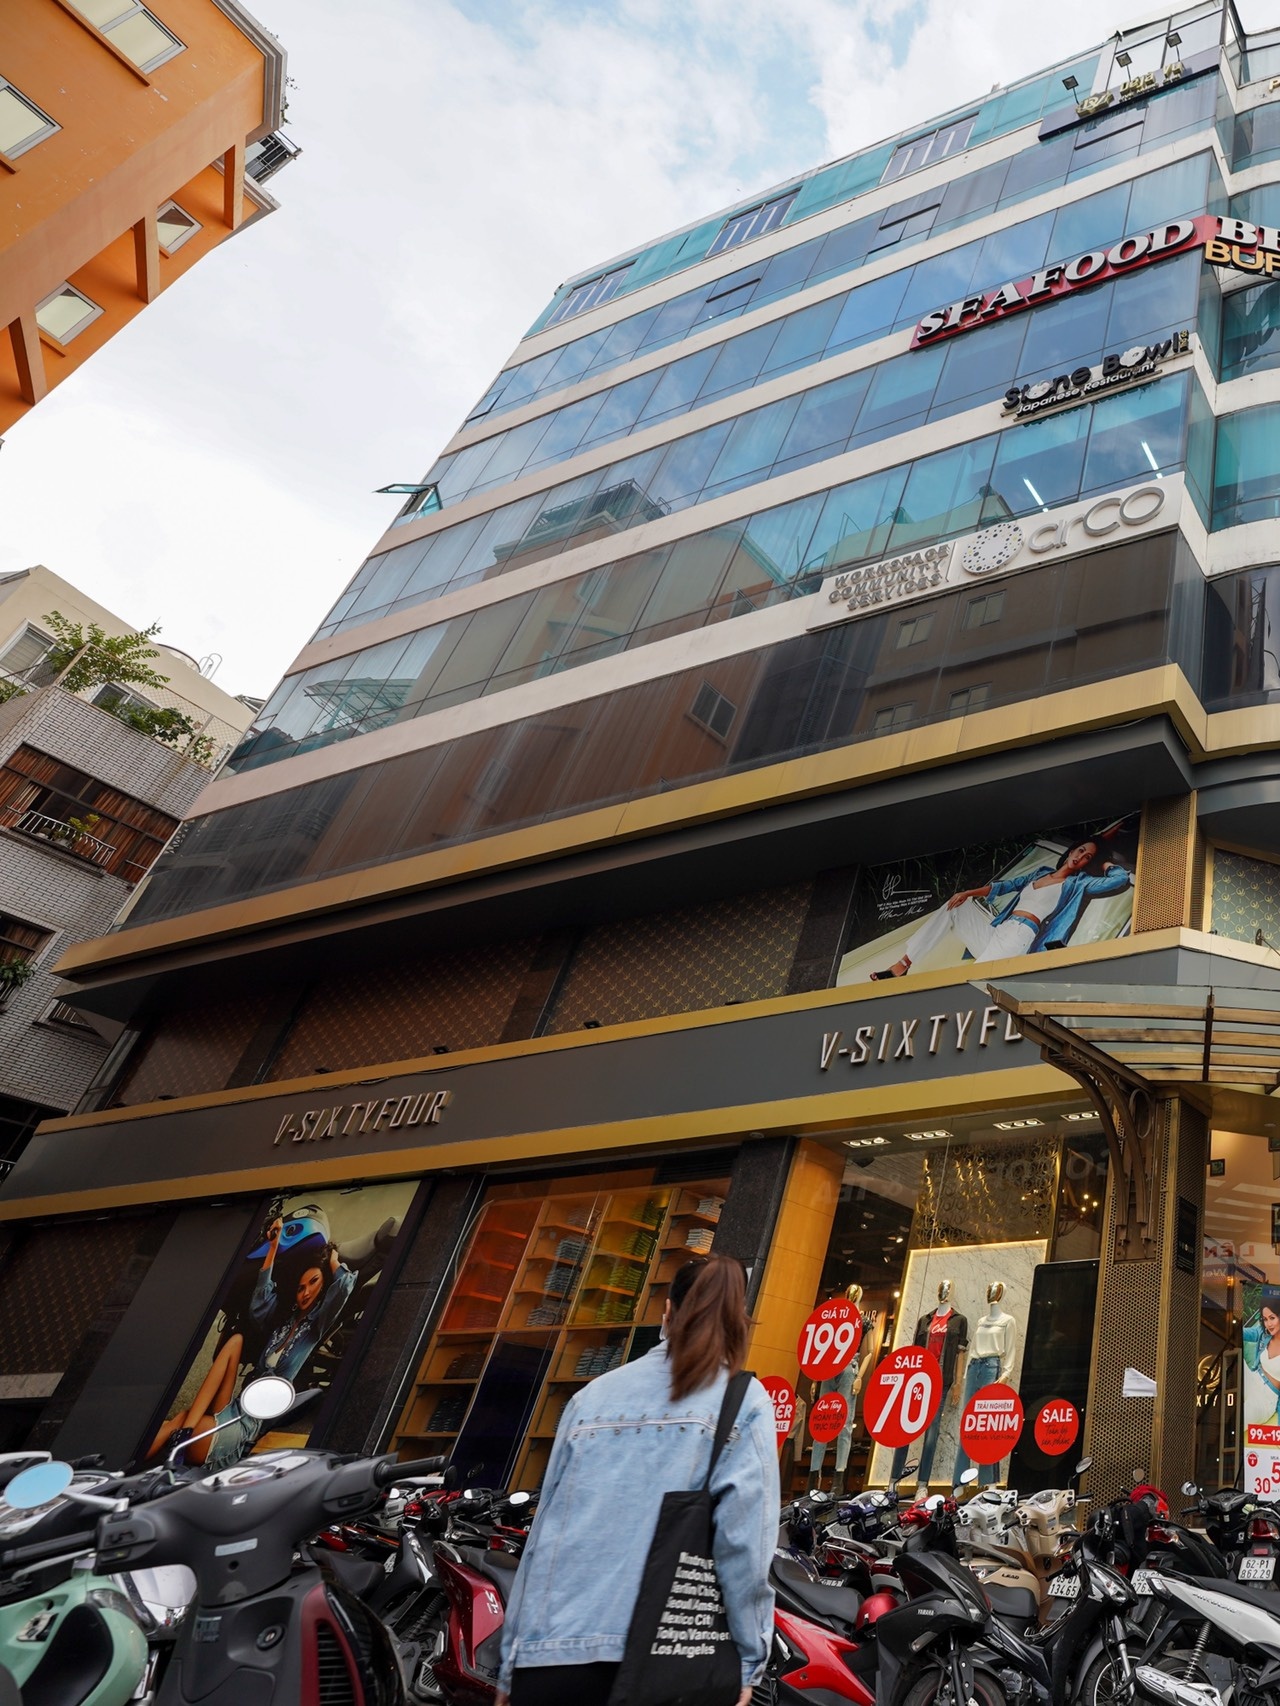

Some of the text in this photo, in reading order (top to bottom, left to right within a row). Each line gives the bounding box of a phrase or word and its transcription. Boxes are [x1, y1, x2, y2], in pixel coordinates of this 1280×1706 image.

[1016, 361, 1156, 415] Japanese Restaurant
[835, 543, 951, 589] WORKSPACE
[828, 558, 943, 604] COMMUNITY
[847, 572, 943, 611] SERVICES
[273, 1090, 450, 1147] V-SIXTYFOUR
[821, 1306, 837, 1320] GIÁ
[894, 1354, 924, 1370] SALE
[882, 1375, 899, 1383] UP TO
[964, 1413, 1020, 1432] DENIM
[1042, 1408, 1073, 1424] SALE
[776, 1422, 787, 1431] ALE
[1244, 1558, 1270, 1569] 62-P1
[1240, 1568, 1273, 1580] 862.29
[1050, 1583, 1078, 1597] 134.65
[917, 1608, 935, 1616] YAMAHA
[694, 1614, 715, 1628] City
[650, 1642, 716, 1659] Los Angeles
